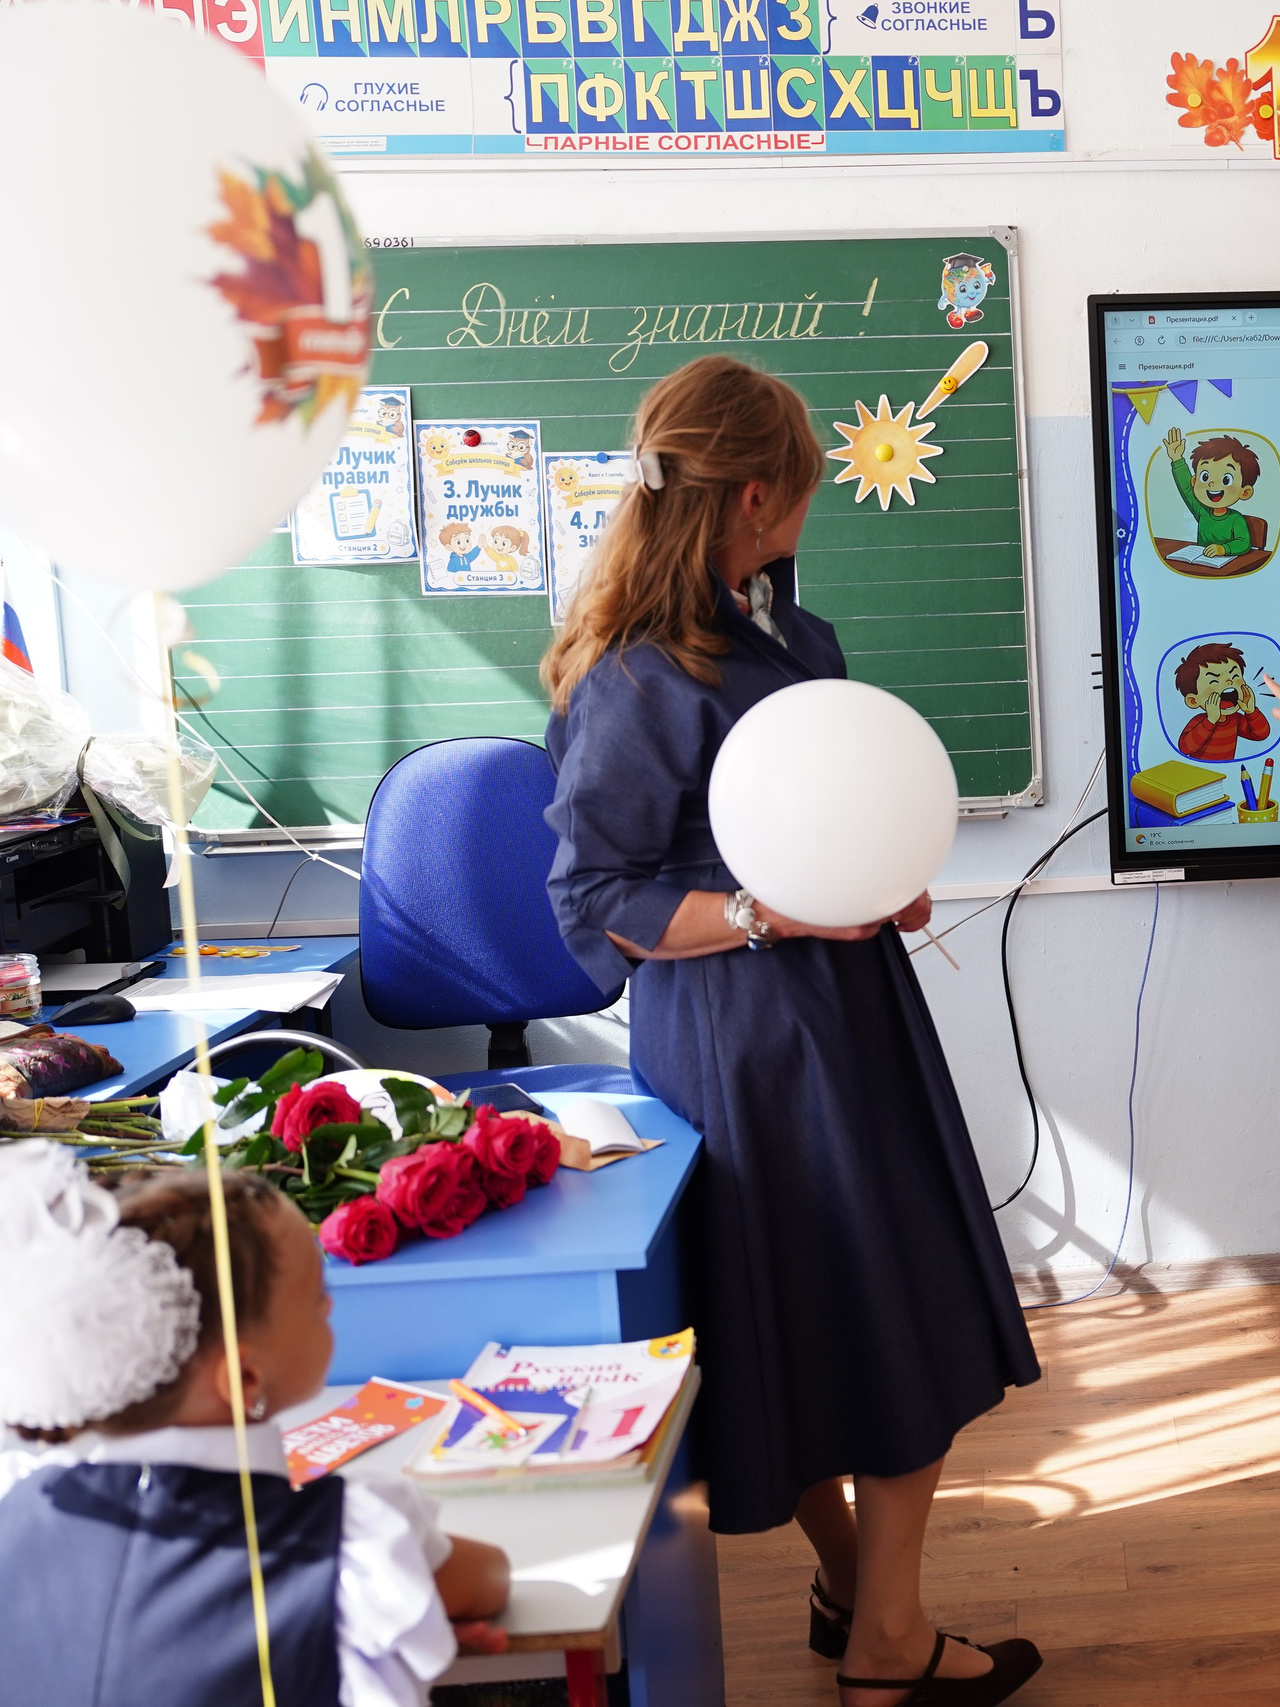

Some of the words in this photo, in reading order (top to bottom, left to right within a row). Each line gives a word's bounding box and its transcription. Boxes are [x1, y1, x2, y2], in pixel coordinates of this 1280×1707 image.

[891, 1, 971, 14] ЗВОНКИЕ
[881, 18, 988, 31] СОГЛАСНЫЕ
[354, 82, 421, 95] ГЛУХИЕ
[335, 99, 446, 112] СОГЛАСНЫЕ
[543, 136, 650, 151] ПАРНЫЕ
[657, 133, 813, 150] СОГЛАСНЫЕ
[376, 287, 410, 349] С
[446, 281, 594, 348] Днём
[608, 290, 824, 373] знаний
[1138, 362, 1196, 371] Презентация.pdf
[336, 446, 397, 470] Лучик
[322, 470, 390, 490] правил
[443, 480, 462, 499] 3.
[465, 480, 523, 503] Лучик
[446, 500, 520, 522] дружбы
[466, 574, 498, 584] Станция
[499, 574, 504, 582] 3
